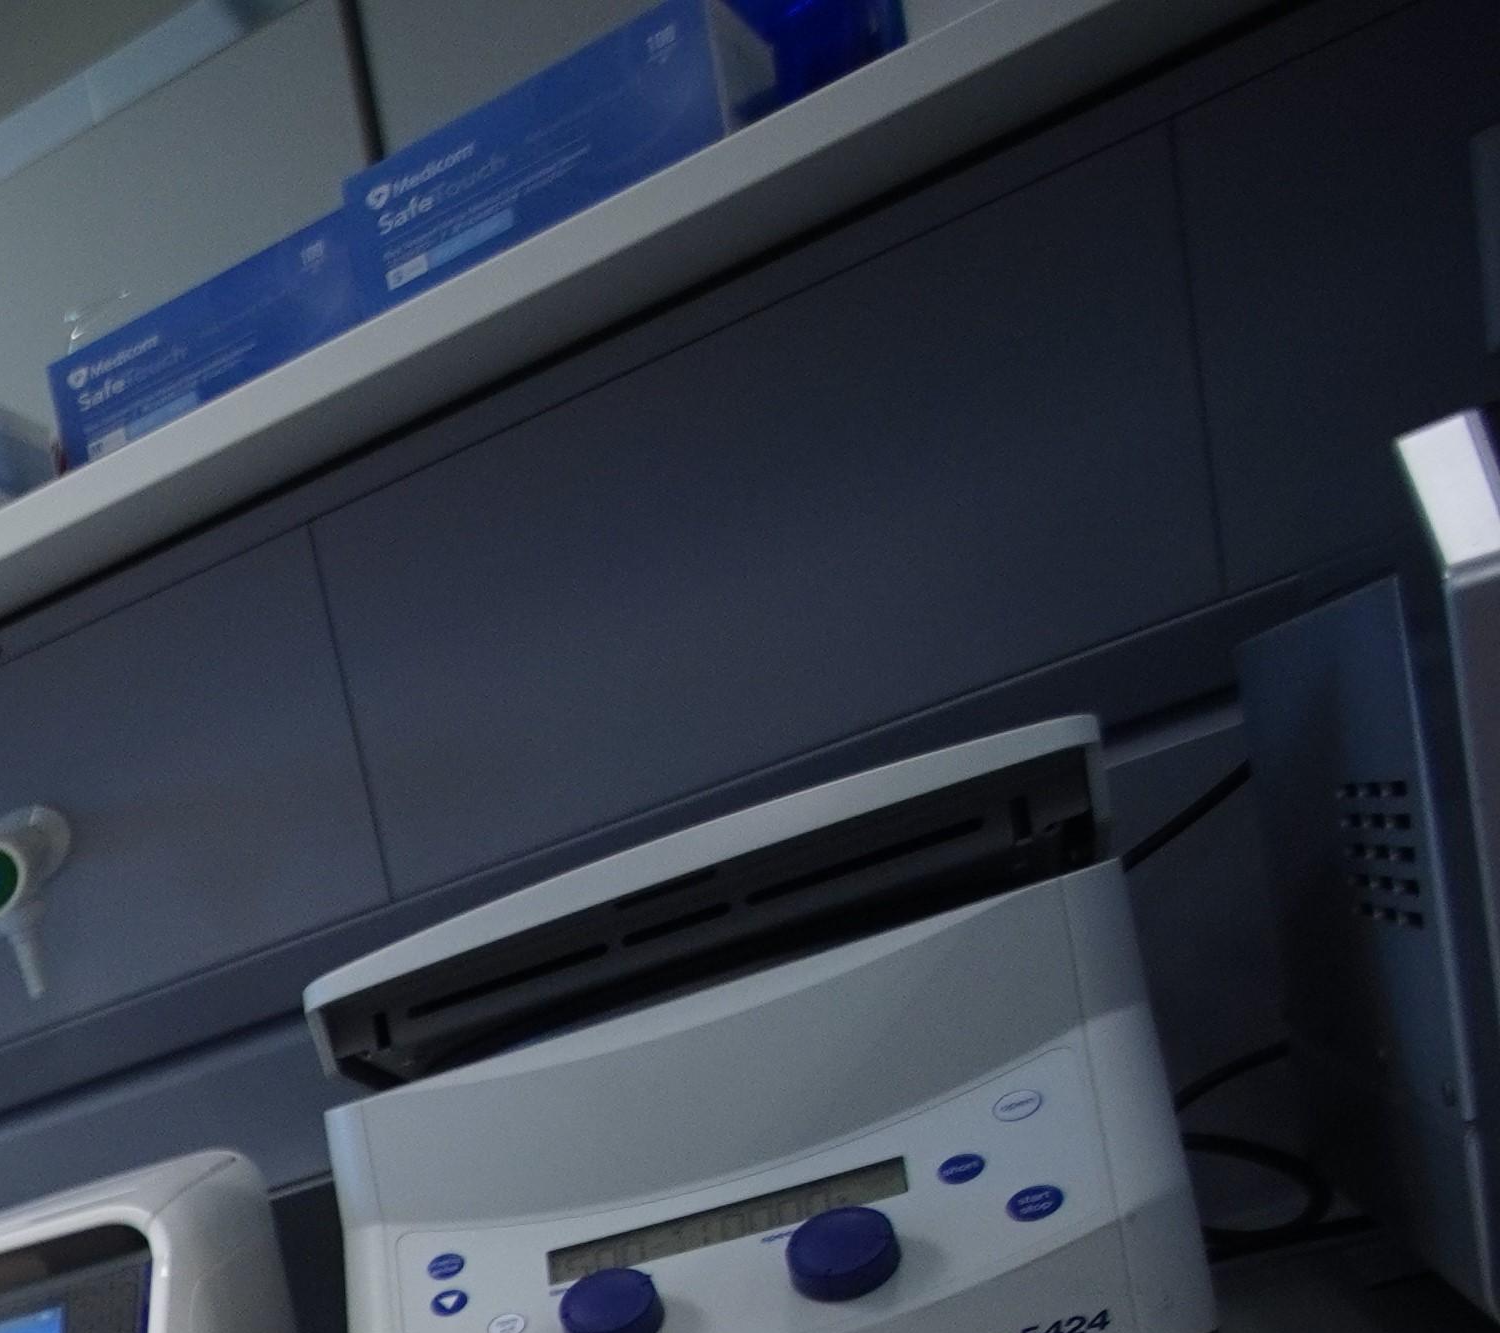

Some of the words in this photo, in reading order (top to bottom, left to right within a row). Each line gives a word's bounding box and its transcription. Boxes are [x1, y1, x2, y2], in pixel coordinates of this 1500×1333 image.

[390, 141, 476, 192] Medicom
[376, 152, 511, 237] SafeTouch
[88, 335, 160, 380] Medicom
